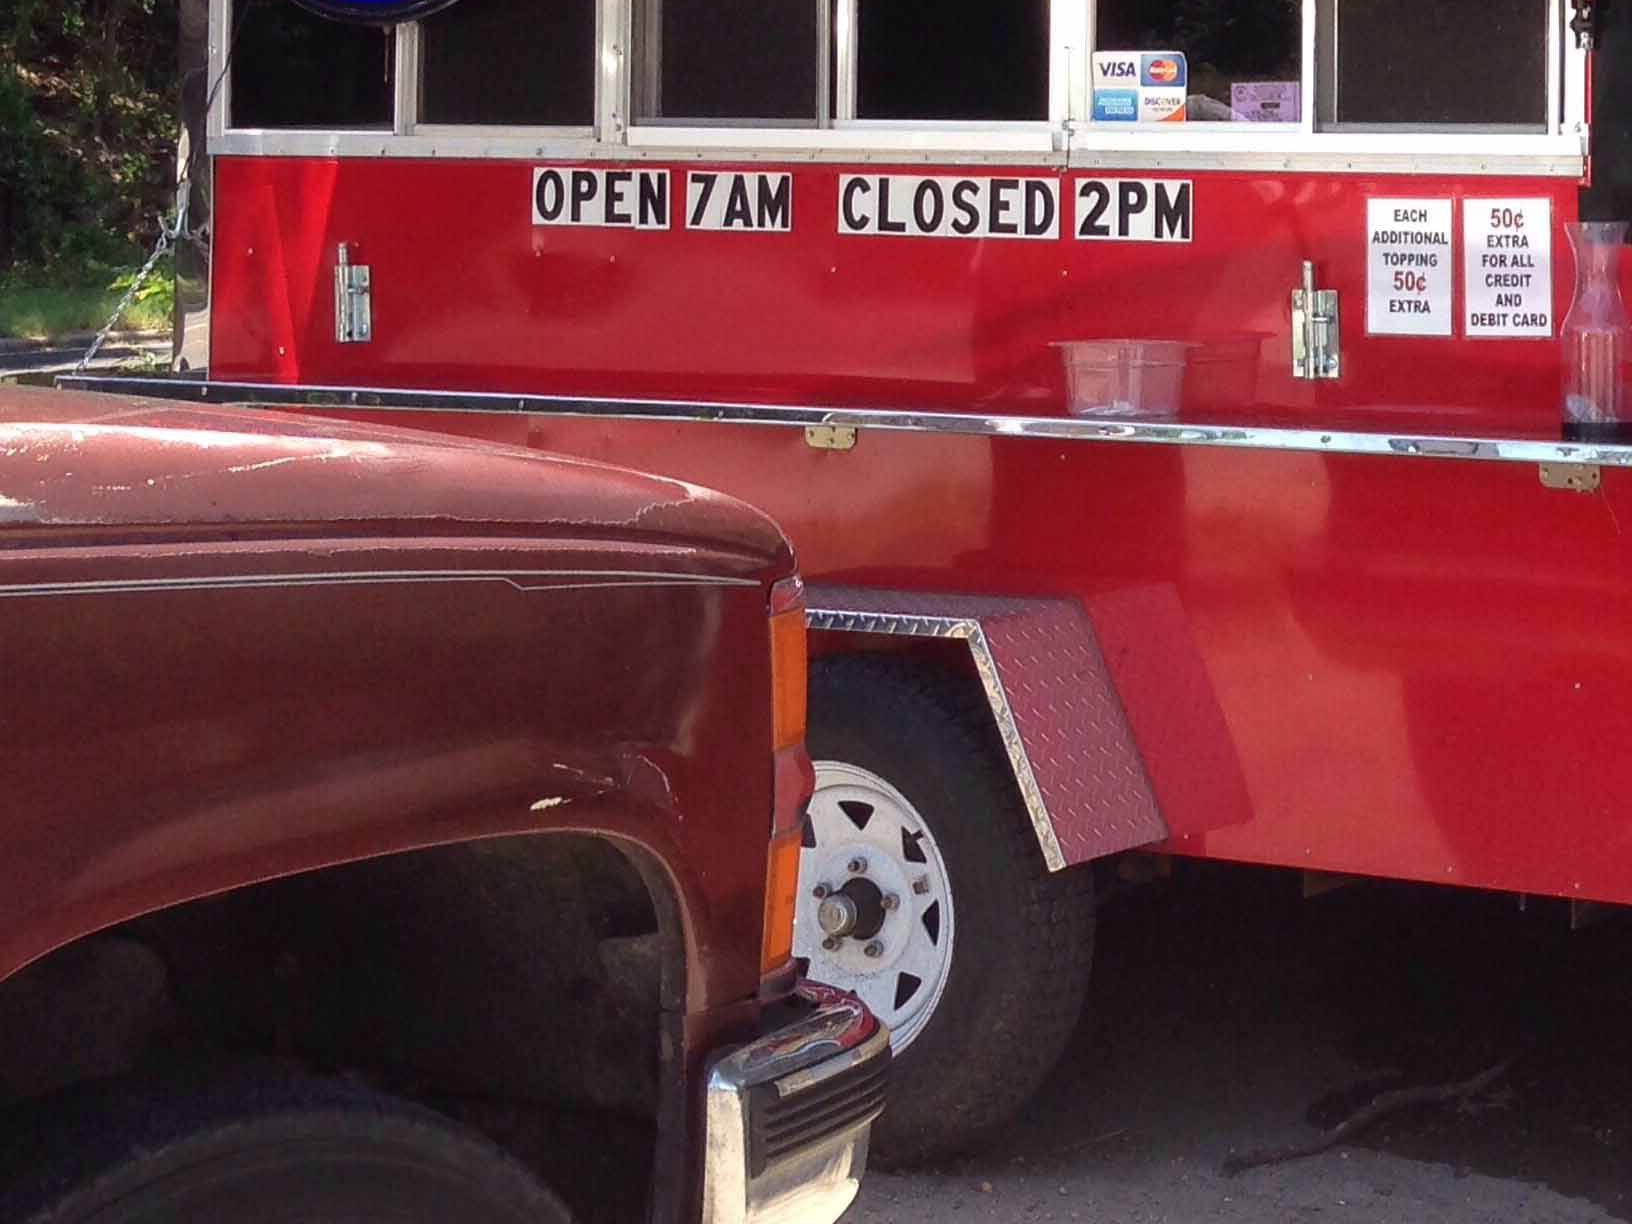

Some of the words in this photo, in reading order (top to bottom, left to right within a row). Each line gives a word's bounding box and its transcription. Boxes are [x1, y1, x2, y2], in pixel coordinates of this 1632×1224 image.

[1099, 62, 1136, 76] VISA
[537, 169, 667, 226] OPEN
[690, 173, 790, 229] 7AM
[843, 176, 1055, 236] CLOSED
[1079, 181, 1190, 239] 2PM
[1394, 210, 1427, 222] EACH
[1491, 208, 1524, 231] 50¢
[1373, 231, 1448, 244] ADDITIONAL
[1487, 235, 1528, 248] EXTRA
[1383, 253, 1437, 267] TOPPING
[1482, 254, 1506, 267] FOR
[1511, 255, 1534, 267] ALL
[1394, 271, 1426, 295] 50¢
[1485, 275, 1531, 287] CREDIT
[1390, 300, 1430, 313] EXTRA
[1496, 294, 1521, 306] AND
[1472, 314, 1508, 326] DEBIT
[1513, 314, 1547, 326] CARD
